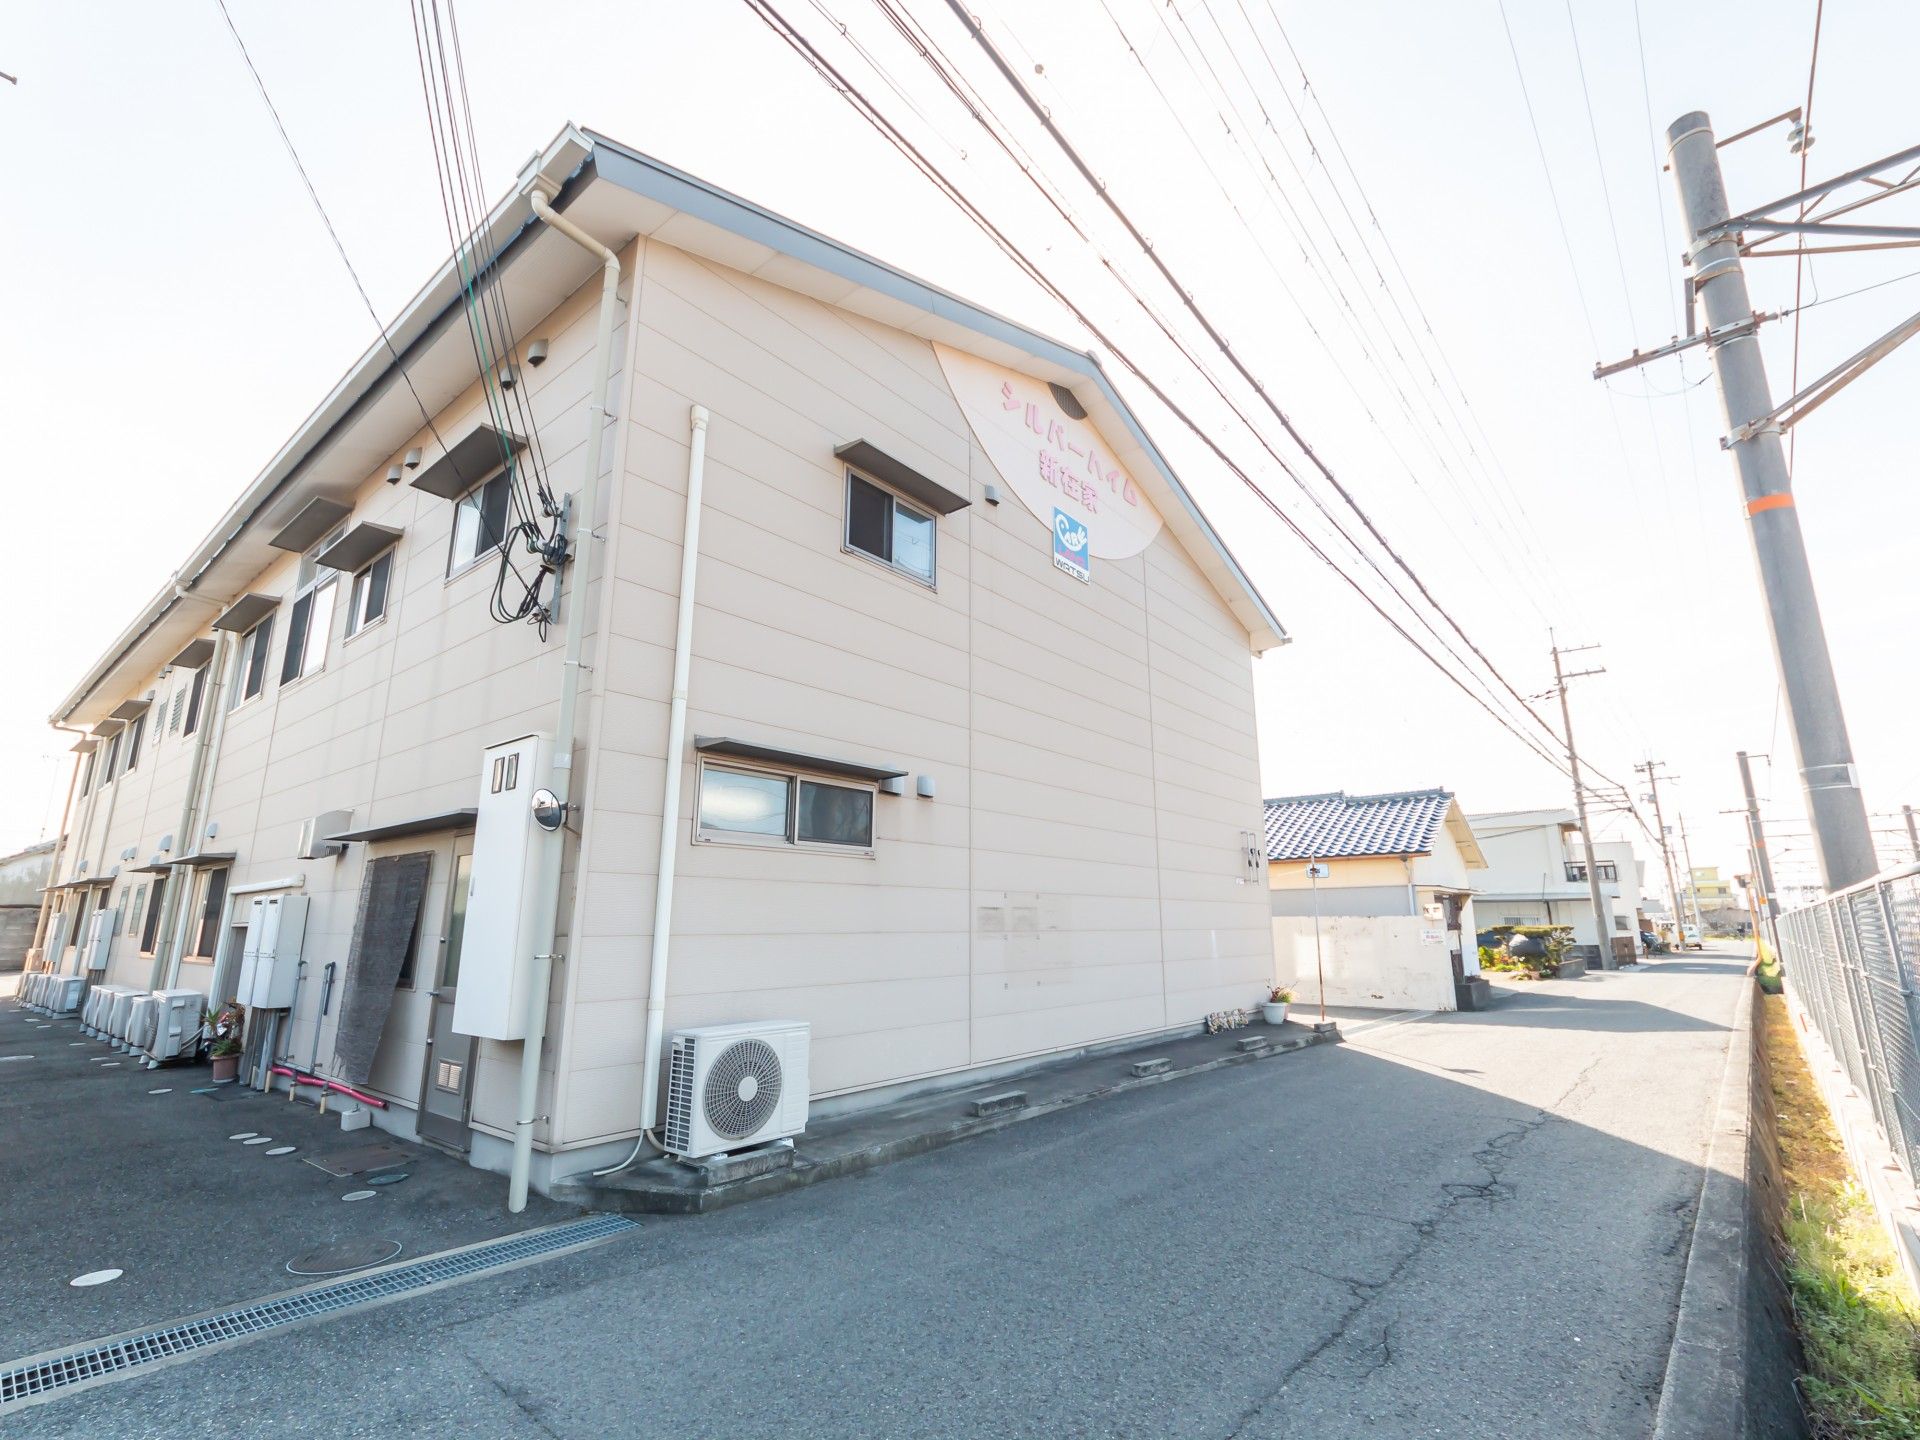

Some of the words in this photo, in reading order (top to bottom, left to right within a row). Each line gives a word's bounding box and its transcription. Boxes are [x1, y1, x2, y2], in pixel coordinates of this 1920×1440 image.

[1001, 381, 1137, 506] シルバーハイム
[1039, 449, 1097, 514] 新在家
